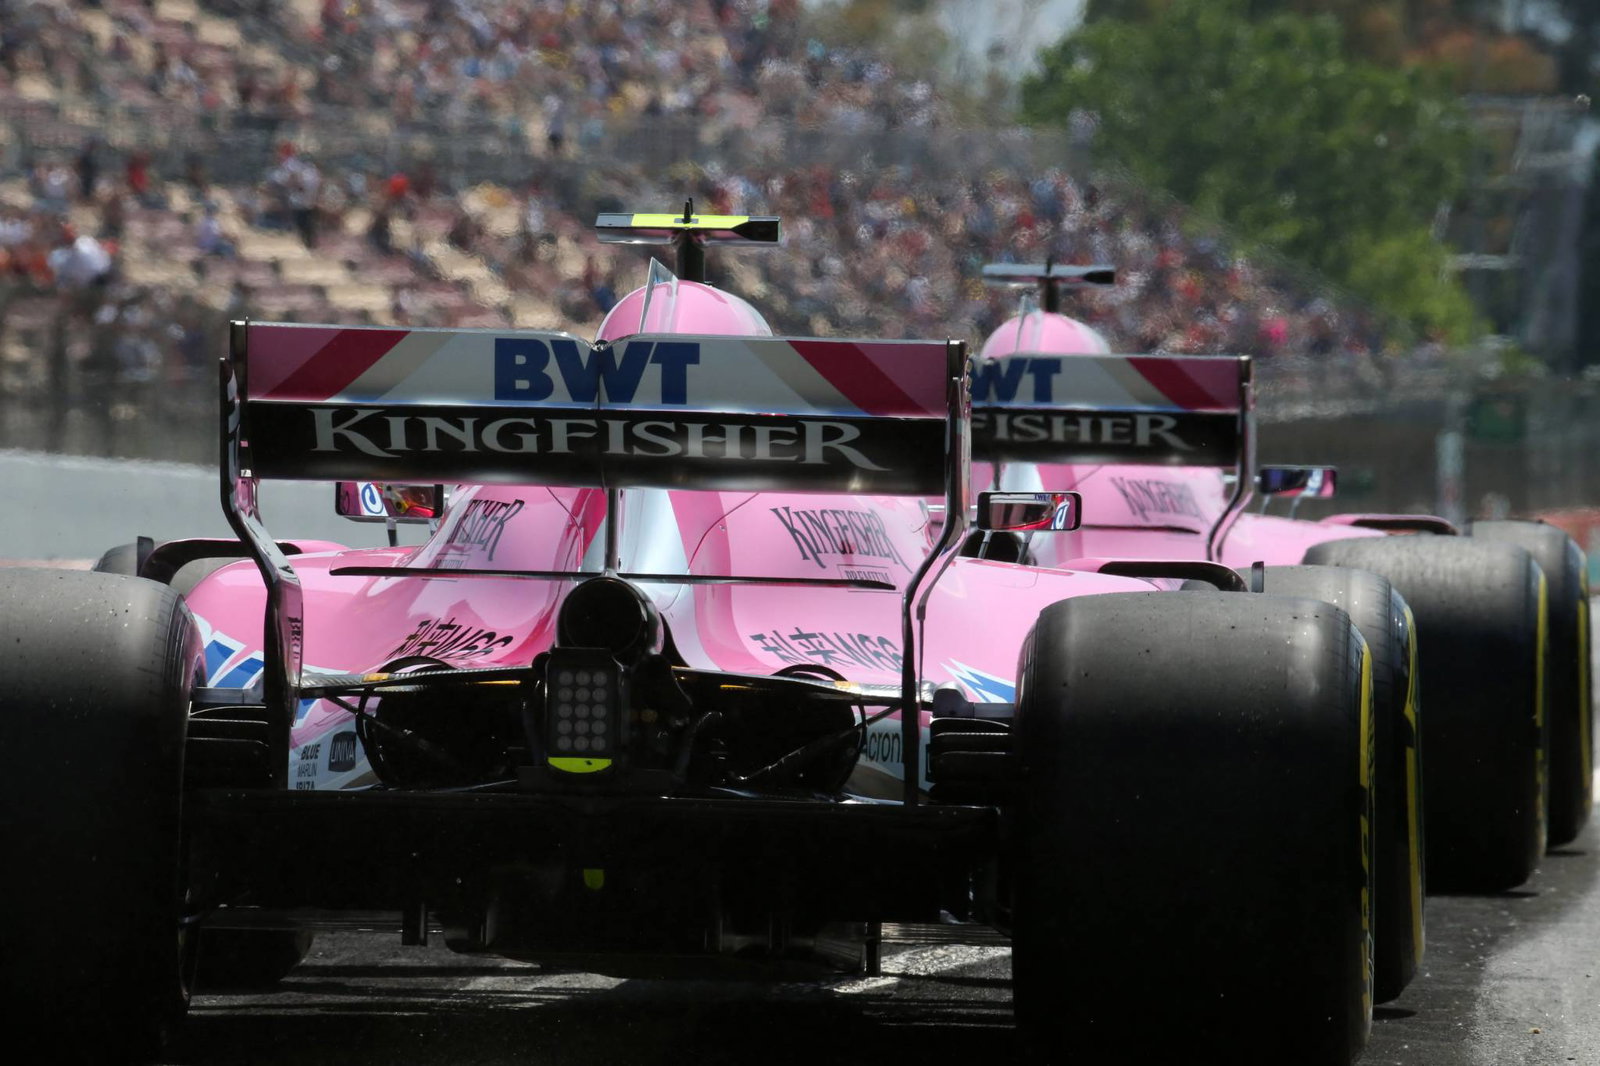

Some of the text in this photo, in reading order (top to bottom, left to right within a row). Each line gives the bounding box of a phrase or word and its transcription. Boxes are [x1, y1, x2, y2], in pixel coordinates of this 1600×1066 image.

[494, 338, 700, 404] BWT
[970, 358, 1062, 402] WT
[308, 408, 893, 471] KINGFISHER
[971, 413, 1196, 451] FISHER
[1109, 476, 1210, 525] KINGFR
[769, 506, 913, 574] KINGFISHER
[301, 744, 321, 760] BLUE
